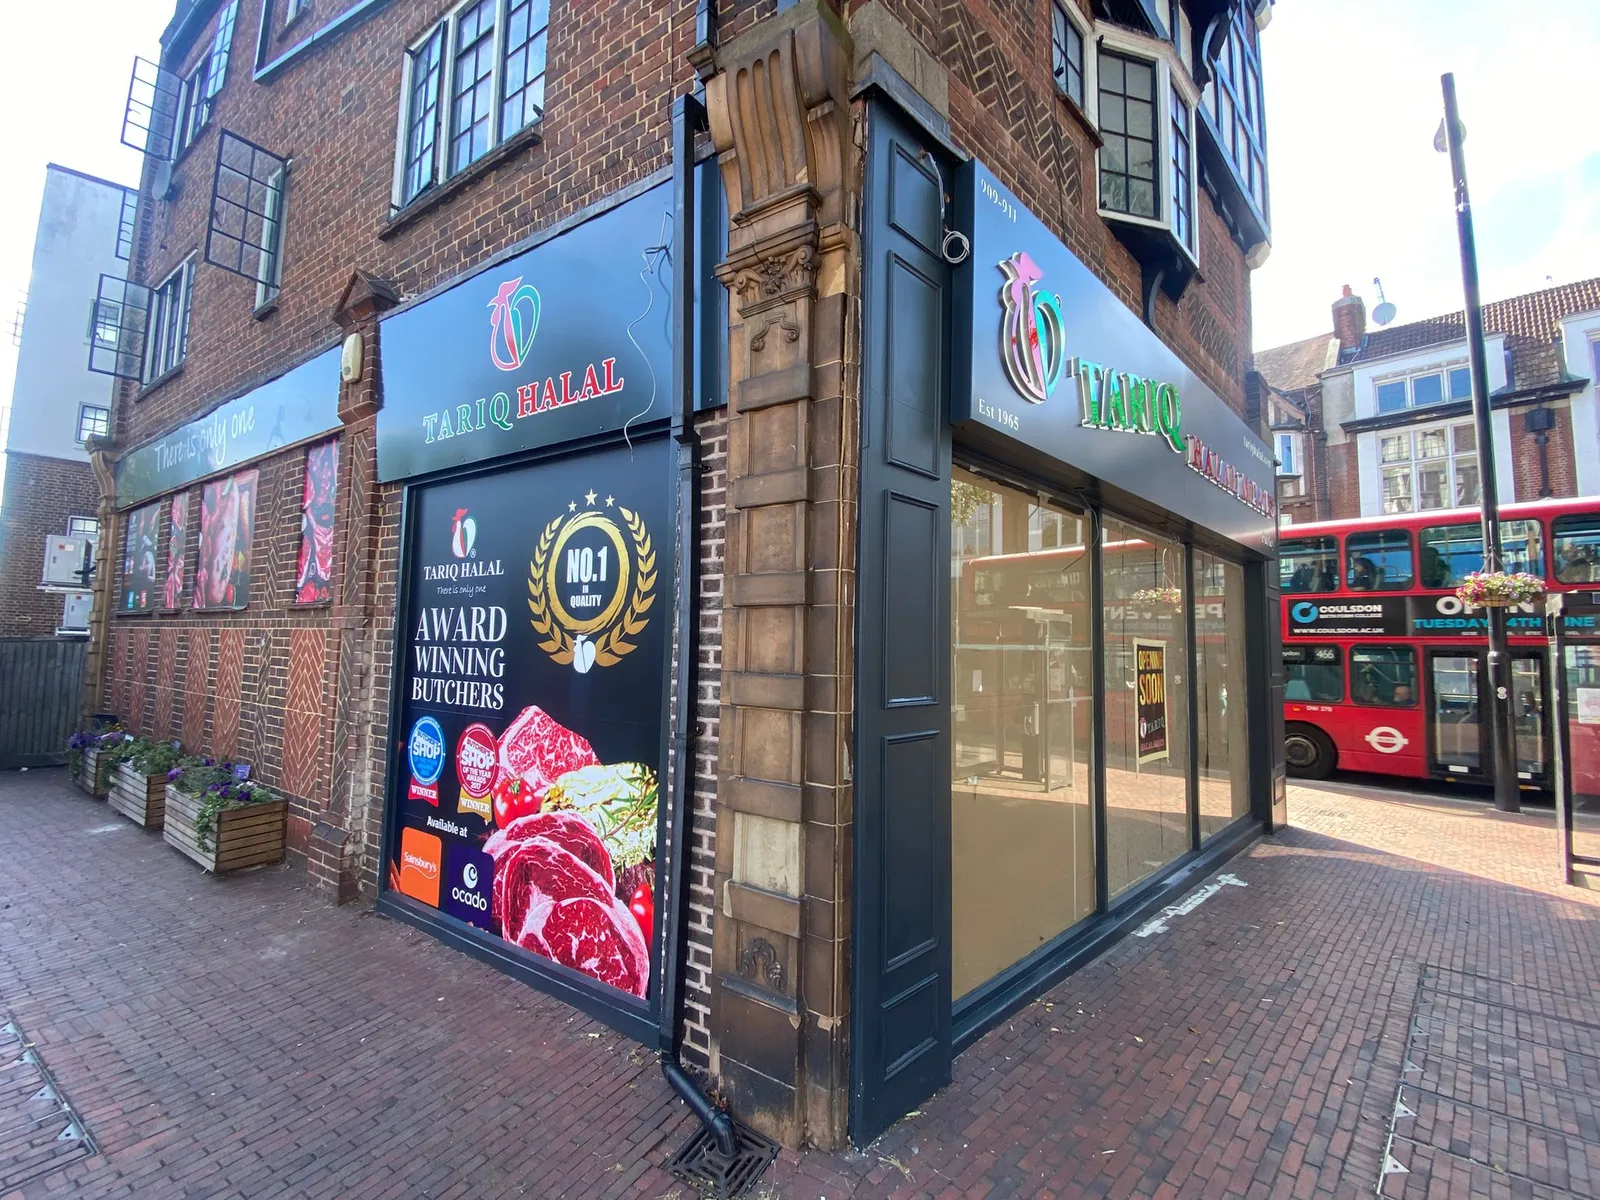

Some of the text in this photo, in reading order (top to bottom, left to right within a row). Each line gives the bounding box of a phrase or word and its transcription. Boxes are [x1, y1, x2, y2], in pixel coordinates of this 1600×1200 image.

[981, 179, 1016, 223] 909-911
[423, 356, 625, 444] TARIQ HALAL
[1066, 356, 1187, 454] TARIQ
[979, 398, 1020, 431] Est 1965
[154, 406, 256, 473] There is only one
[423, 560, 505, 582] TARIQ HALAL
[566, 546, 608, 583] NO.1
[436, 584, 487, 597] There is only one
[582, 584, 589, 594] IN
[570, 594, 602, 608] QUALITY
[1319, 605, 1383, 614] COULSDON
[414, 606, 508, 642] AWARD
[414, 645, 506, 678] WINNING
[1138, 650, 1163, 671] OPENING
[1315, 650, 1335, 660] 466
[411, 677, 504, 710] BUTCHERS
[1139, 673, 1164, 706] SOON
[413, 740, 441, 759] SHOP
[461, 747, 495, 770] SHOP
[466, 774, 487, 784] AWARDS
[469, 768, 478, 776] THE
[478, 769, 492, 778] YEAR
[411, 784, 438, 800] WINNER
[459, 797, 490, 813] WINNER
[427, 815, 468, 838] Available at
[403, 851, 437, 873] Sainsbury's
[451, 887, 488, 911] ocado
